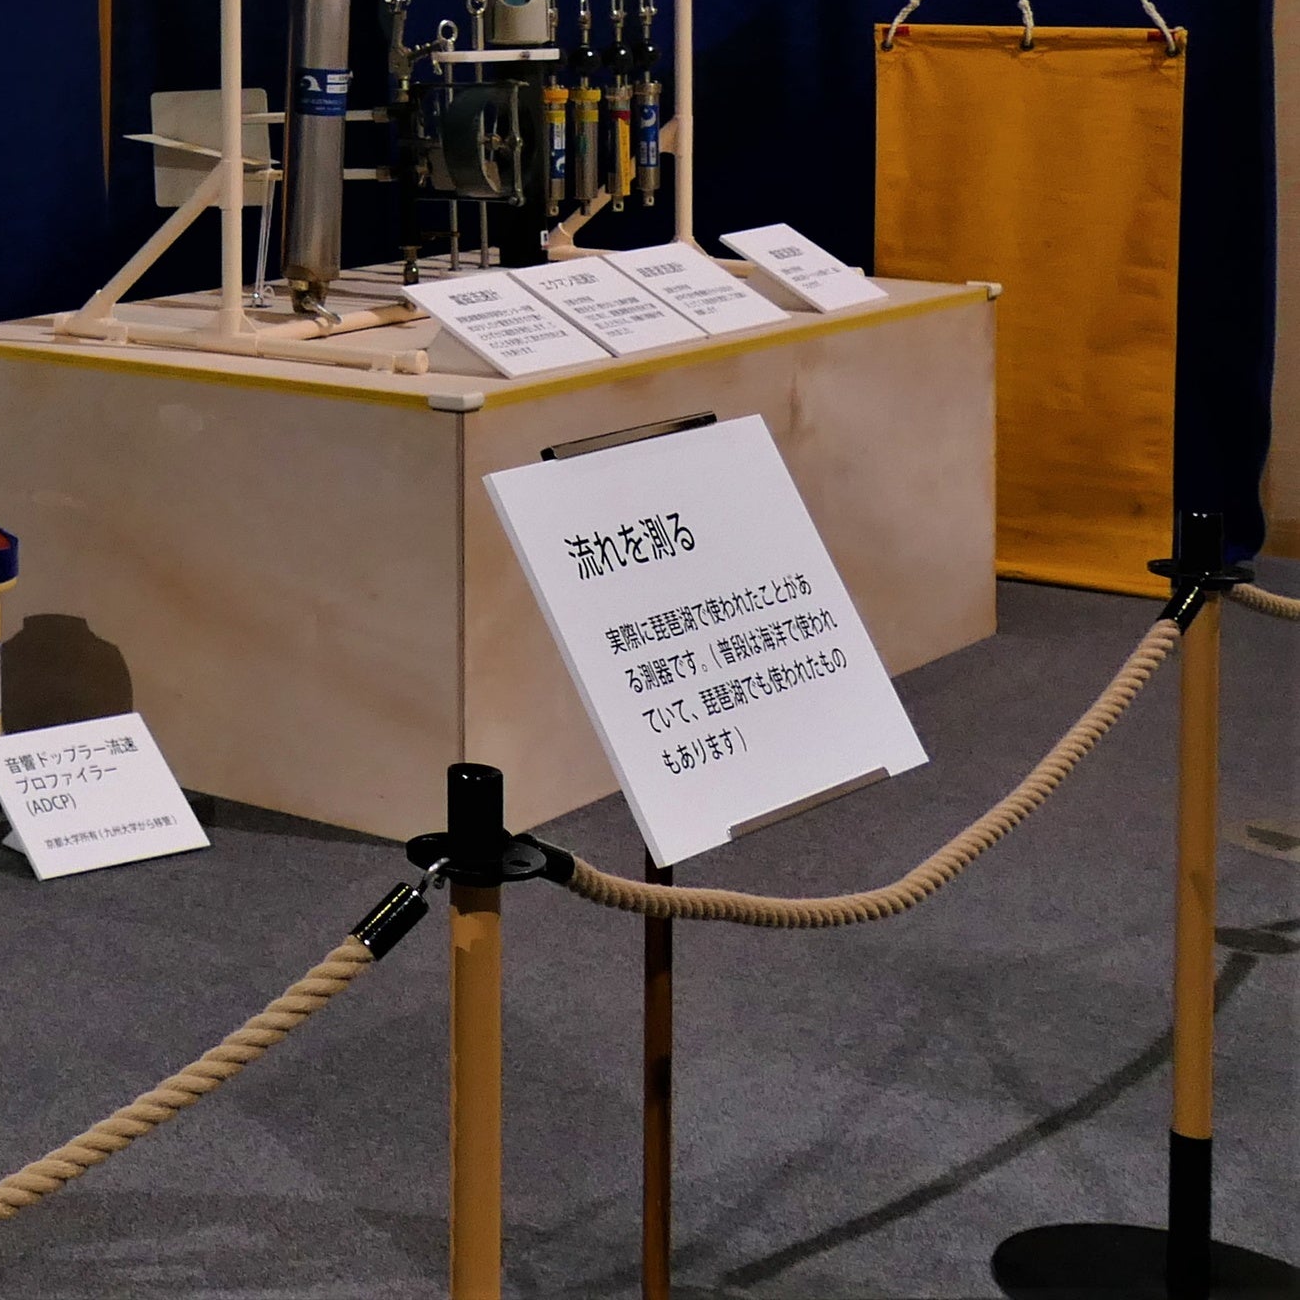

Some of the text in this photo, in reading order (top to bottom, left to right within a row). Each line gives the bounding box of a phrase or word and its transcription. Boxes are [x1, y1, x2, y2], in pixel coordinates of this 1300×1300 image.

[564, 512, 696, 580] 流れを測る
[605, 572, 813, 655] 実際に琵琶湖で使われたことがあ
[642, 648, 848, 735] ていて、琵琶湖でも使われたもの
[4, 736, 139, 775] 音響ドップラー流速
[16, 764, 118, 795] プロファイラー
[25, 794, 77, 817] (ADCP)
